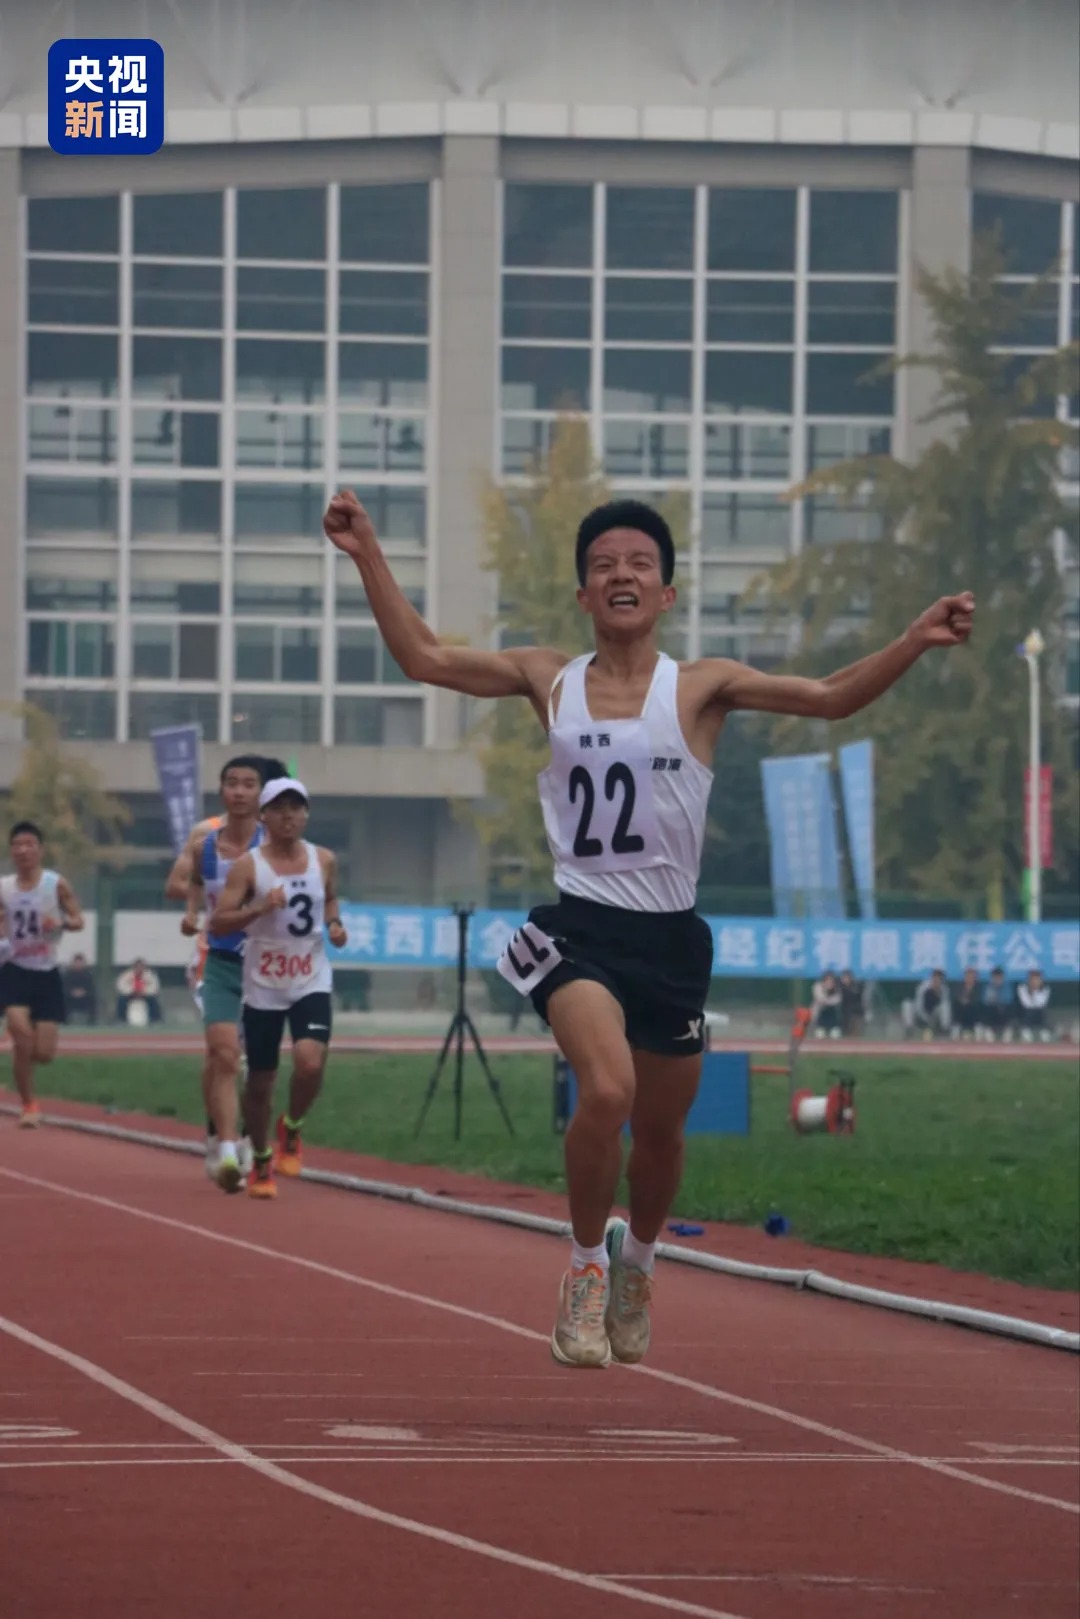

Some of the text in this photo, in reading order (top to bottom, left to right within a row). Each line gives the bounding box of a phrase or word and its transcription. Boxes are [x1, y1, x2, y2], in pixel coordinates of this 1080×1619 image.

[579, 733, 611, 749] 陕西
[568, 761, 645, 858] 22
[14, 909, 39, 940] 24
[287, 892, 314, 938] 3
